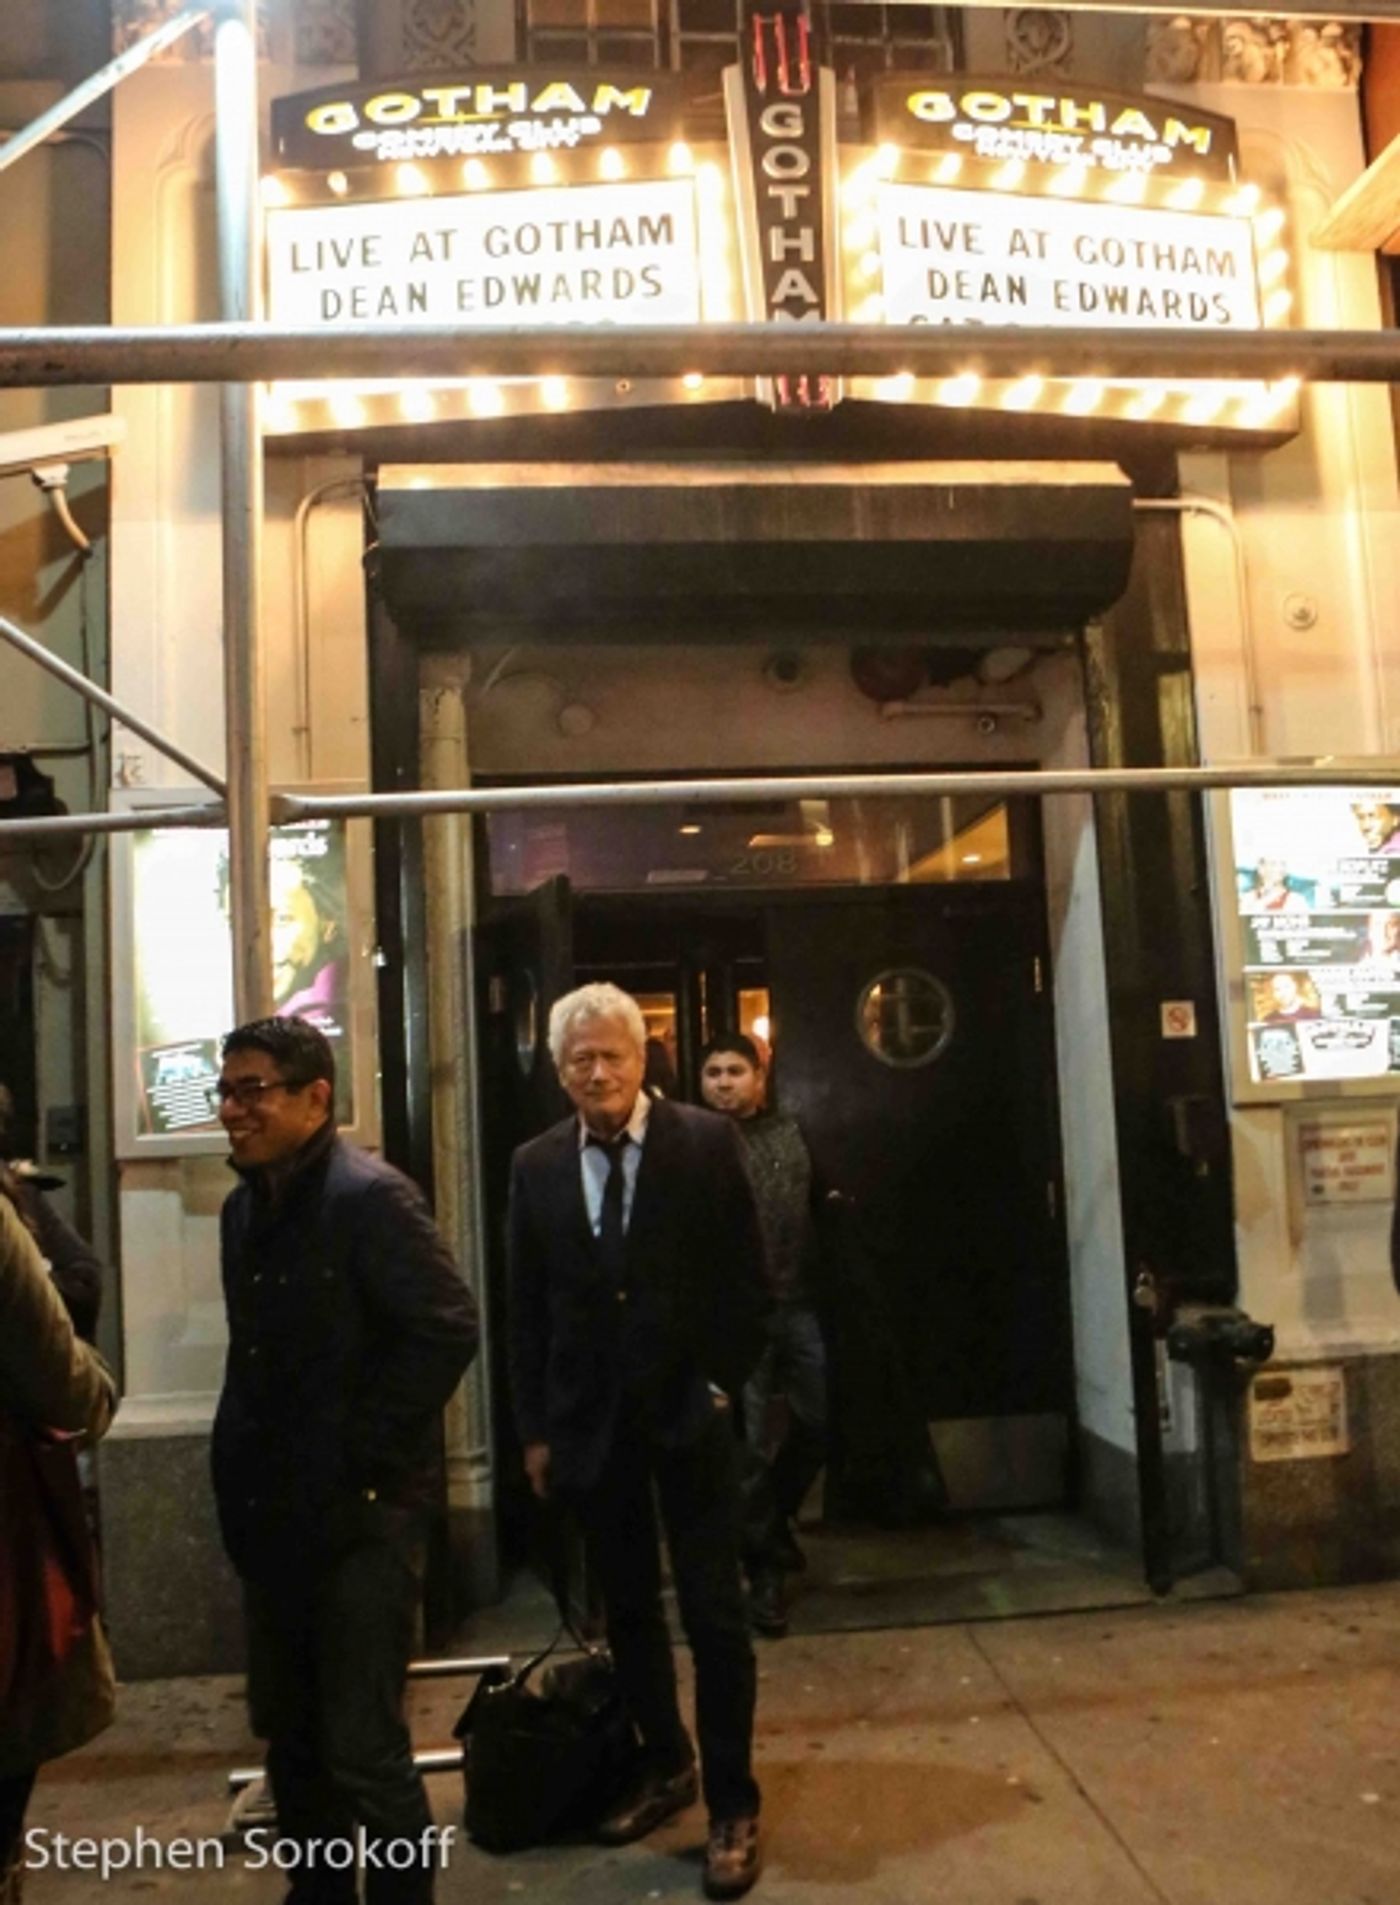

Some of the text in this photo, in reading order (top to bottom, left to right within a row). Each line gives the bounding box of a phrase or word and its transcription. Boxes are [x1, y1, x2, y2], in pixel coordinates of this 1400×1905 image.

[306, 82, 652, 135] GOTHAM
[907, 91, 1211, 154] GOTHAM
[290, 213, 675, 273] LIVE AT GOTHAM
[899, 217, 1237, 278] LIVE AT GOTHAM
[321, 264, 663, 321] DEAN EDWARDS
[927, 268, 1232, 324] DEAN EDWARDS
